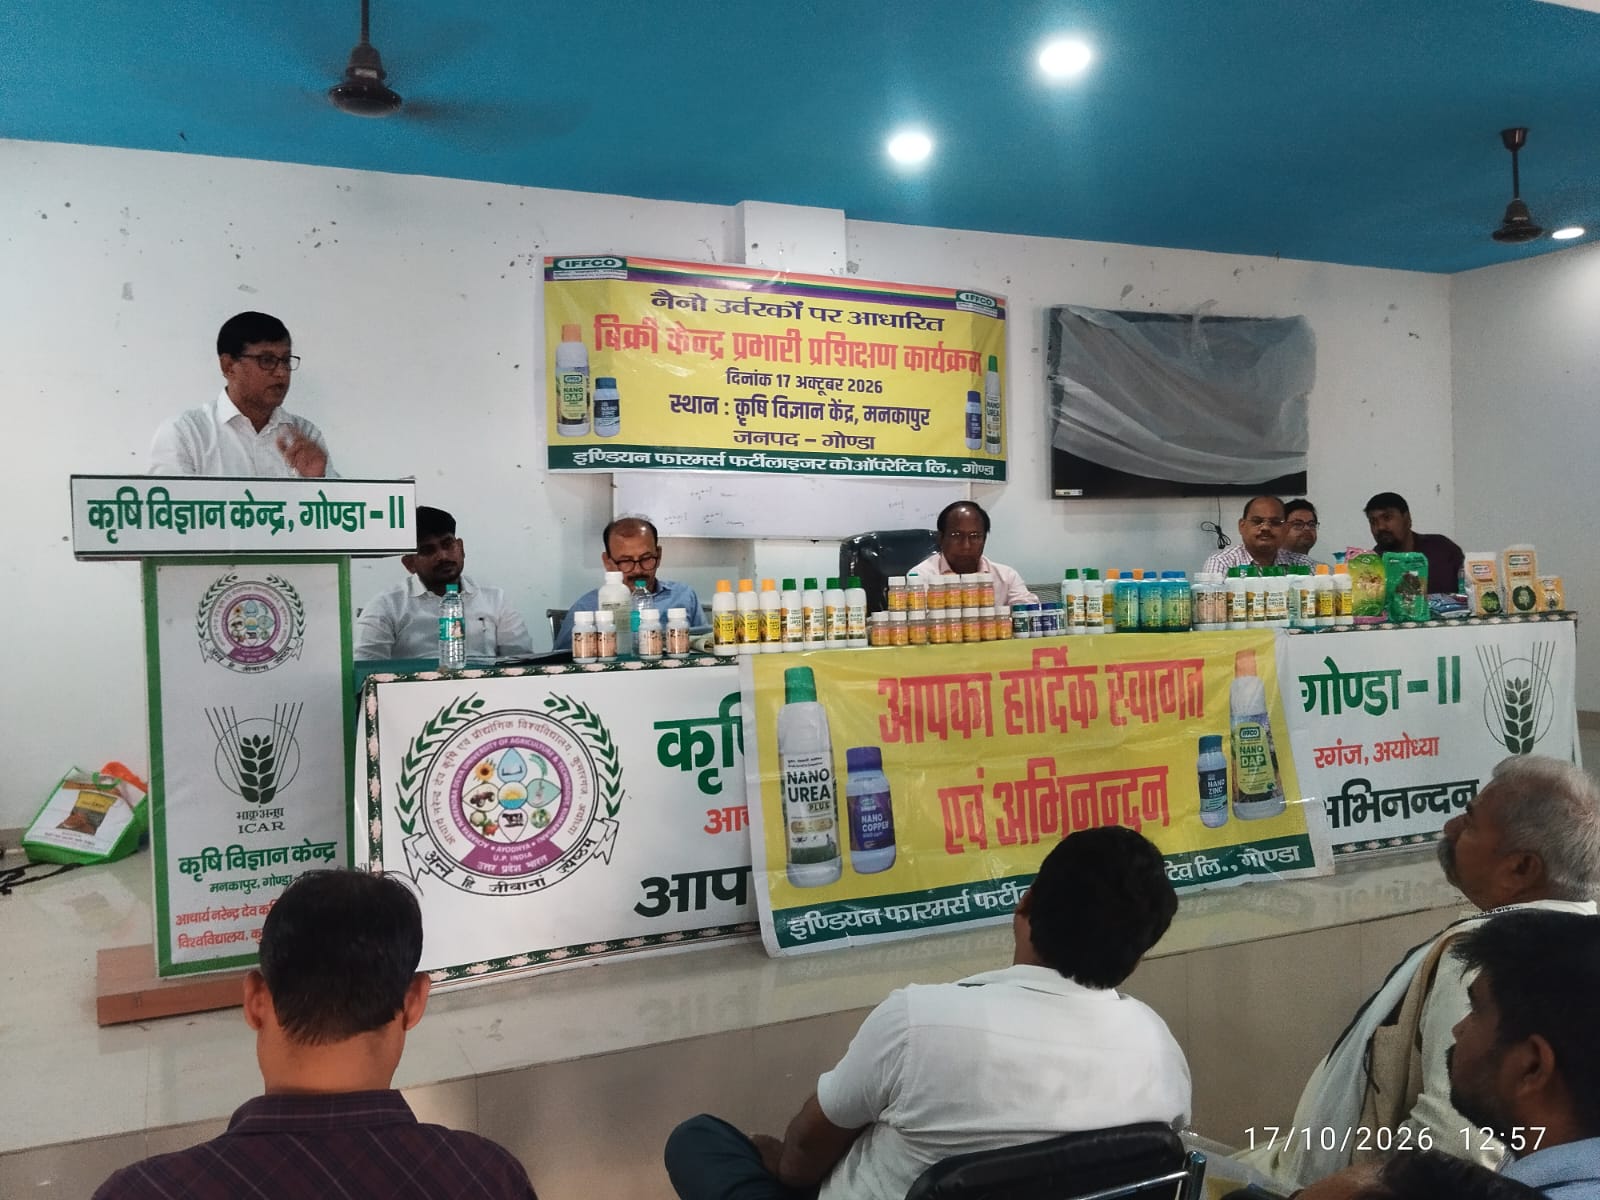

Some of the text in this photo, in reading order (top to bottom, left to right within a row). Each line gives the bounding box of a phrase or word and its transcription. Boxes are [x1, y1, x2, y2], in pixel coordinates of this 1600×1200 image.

[564, 258, 617, 268] IFFCO
[650, 288, 945, 332] नैनो उर्वरकों पर आधारित
[963, 293, 994, 306] IFFCO
[594, 314, 982, 377] बिक्री केन्द्र प्रभारी प्रशिक्षण कार्यक्रम
[725, 367, 884, 396] दिनांक 17 अक्टूबर 2026
[668, 394, 720, 416] स्थान
[733, 393, 769, 427] कृषि
[772, 395, 825, 423] विज्ञान
[828, 397, 860, 426] केंद्र,
[862, 405, 932, 432] मनकापुर
[733, 430, 801, 447] जनपद
[821, 430, 877, 450] गोण्डा
[573, 448, 652, 467] इण्डियन
[654, 451, 727, 468] फारमर्स
[728, 453, 828, 471] फर्टीलाइजर
[828, 456, 923, 474] कोऑपरेटिव
[961, 462, 995, 477] गोण्डा
[87, 486, 143, 544] कृषि
[147, 486, 226, 535] विज्ञान
[229, 489, 295, 536] केन्द्र,
[299, 490, 367, 533] गोण्डा
[878, 645, 1206, 744] आपका हार्दिक स्वागत
[1239, 745, 1264, 754] NANO
[1313, 732, 1440, 770] रगंज, अयोध्या
[1241, 755, 1266, 768] DAP
[786, 767, 830, 785] NANO
[787, 784, 831, 803] UREA
[1208, 786, 1223, 795] ZINC
[937, 756, 1171, 855] एवं अभिनन्दन
[238, 821, 285, 834] ICAR
[861, 813, 883, 824] NANO
[178, 838, 338, 883] कृषि विज्ञान केन्द्र
[510, 852, 533, 861] INDIA
[209, 878, 261, 895] मनकापुर,
[633, 866, 752, 918] आप
[788, 909, 882, 941] इण्डियन
[884, 888, 971, 924] फारमर्स
[1237, 845, 1301, 868] गोण्डा
[176, 906, 210, 926] आचार्य
[211, 905, 241, 921] नरेन्द्र
[242, 903, 257, 917] देव
